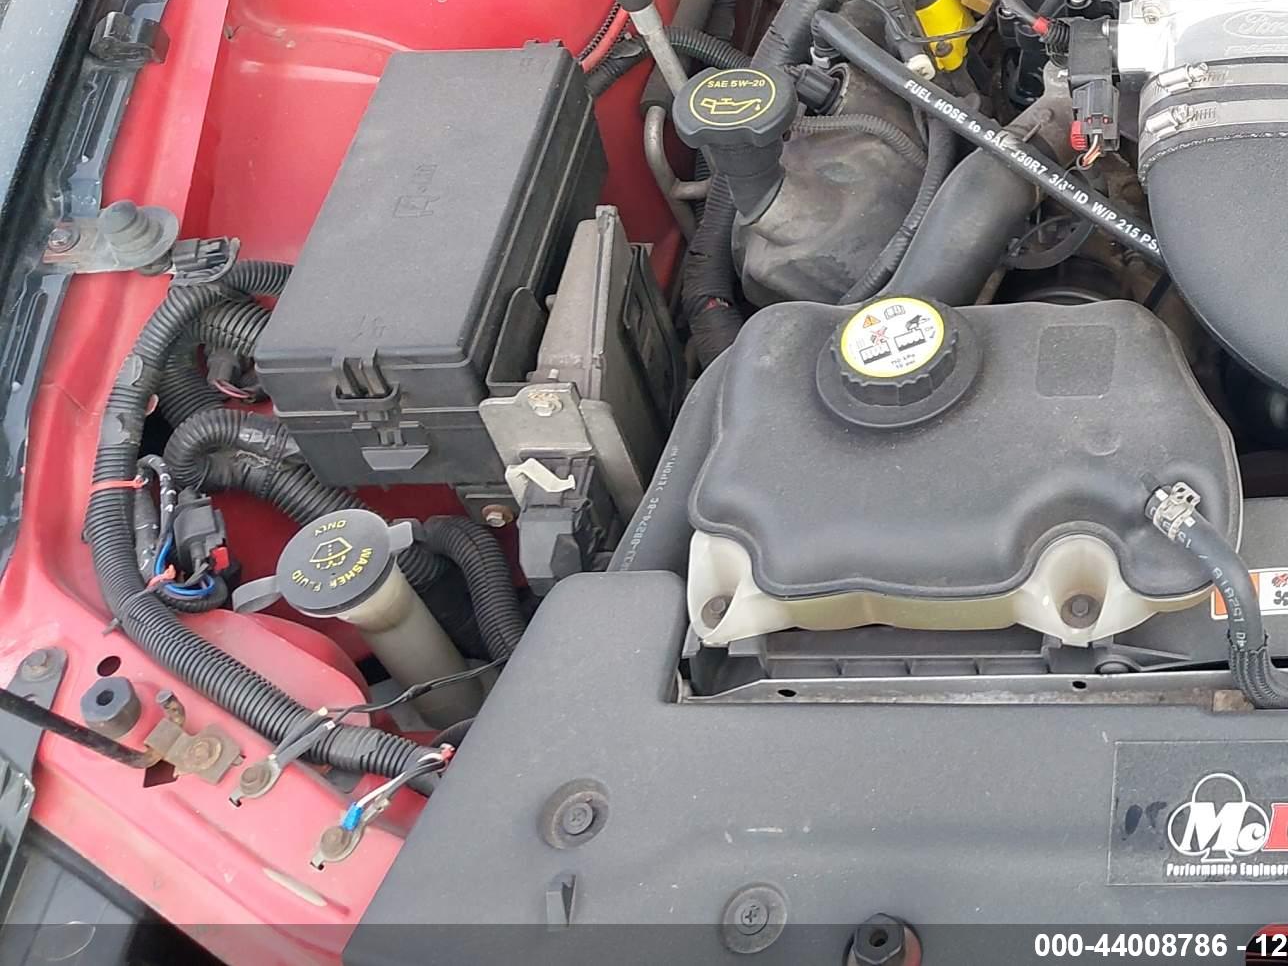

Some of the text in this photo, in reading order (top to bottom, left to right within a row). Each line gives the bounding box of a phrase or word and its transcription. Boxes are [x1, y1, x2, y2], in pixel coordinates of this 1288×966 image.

[707, 79, 766, 88] SAE 5W-20
[904, 79, 931, 103] FUEL
[934, 98, 967, 125] HOSE
[968, 120, 980, 134] to
[984, 129, 1009, 152] SAE
[1010, 148, 1049, 176] J30R7
[1073, 190, 1090, 206] ID
[1091, 201, 1118, 224] W/P
[1114, 218, 1141, 238] 215
[314, 519, 347, 537] ONLY
[330, 547, 374, 588] WASHER
[1166, 862, 1238, 877] Performance
